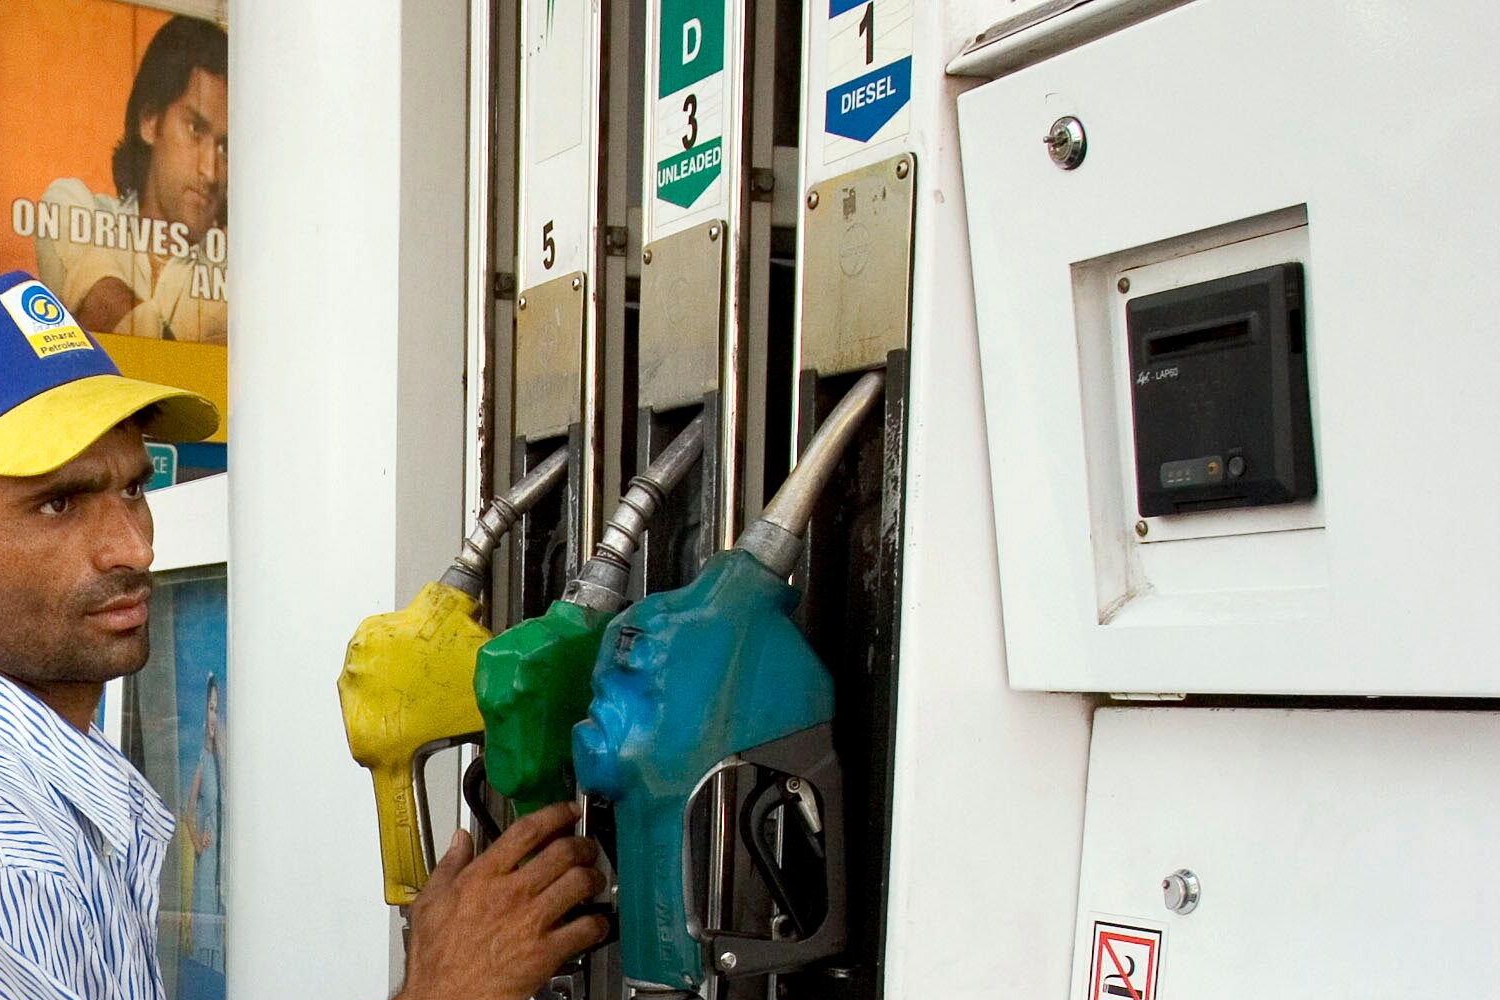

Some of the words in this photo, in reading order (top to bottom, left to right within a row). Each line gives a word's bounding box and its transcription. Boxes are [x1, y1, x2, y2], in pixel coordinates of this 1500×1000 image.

[682, 17, 702, 66] D
[859, 1, 874, 65] 1
[841, 75, 897, 115] DIESEL
[682, 93, 698, 151] 3
[657, 146, 722, 188] UNLEADED
[12, 199, 60, 240] ON
[542, 220, 556, 270] 5
[42, 330, 77, 343] Bharat
